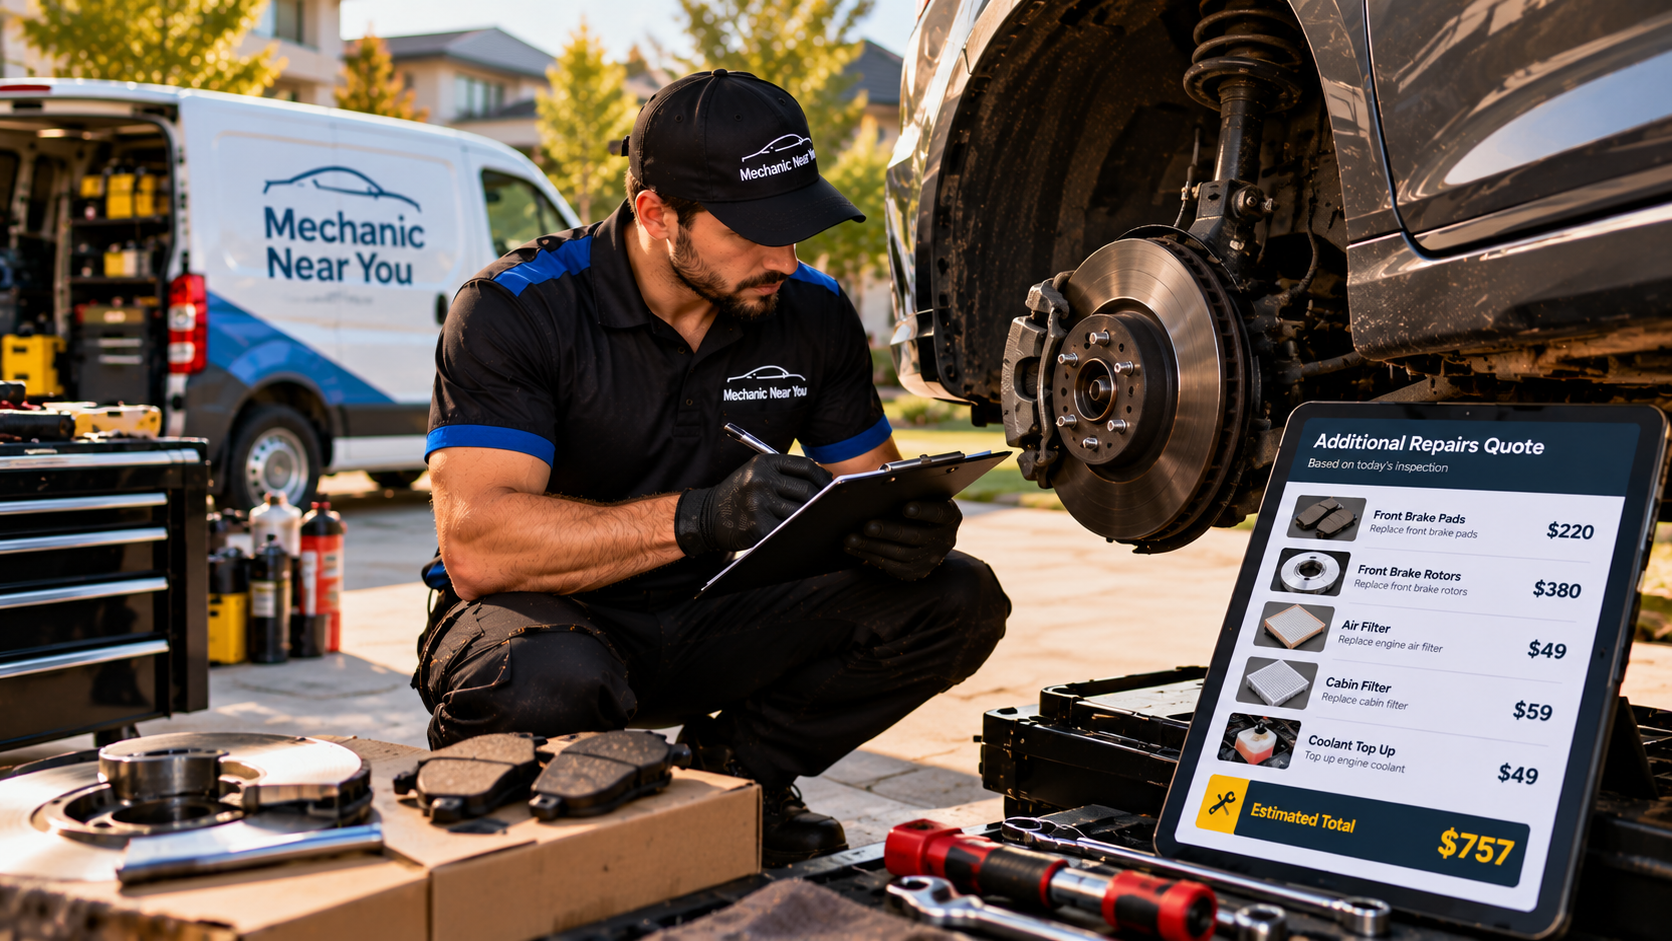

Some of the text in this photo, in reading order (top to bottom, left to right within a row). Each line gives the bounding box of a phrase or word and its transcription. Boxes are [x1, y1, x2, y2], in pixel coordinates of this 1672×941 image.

[740, 159, 792, 181] Mechanic
[792, 153, 809, 168] Near
[264, 206, 425, 249] Mechanic
[267, 246, 412, 285] Near You
[723, 385, 807, 401] Mechanic Near You
[1313, 433, 1545, 455] Additional Repairs Quote
[1308, 458, 1448, 473] Based on today's inspection
[1373, 510, 1466, 524] Front Brake Pads
[1369, 524, 1478, 540] Replace front brake pads
[1546, 520, 1595, 540] $220
[1358, 564, 1462, 582] Front Brake Rotors
[1354, 579, 1468, 596] Replace front brake rotors
[1532, 579, 1582, 599] $380
[1341, 620, 1392, 634] Air Filter
[1338, 635, 1443, 653] Replace engine air filter
[1527, 639, 1567, 660] $49
[1325, 677, 1392, 694] Cabin Filter
[1322, 692, 1408, 710] Replace cabin filter
[1513, 700, 1553, 721] $59
[1308, 735, 1396, 757] Coolant Top Up
[1304, 750, 1406, 774] Top up engine coolant
[1498, 762, 1538, 785] $49
[1250, 802, 1357, 834] Estimated Total
[1437, 827, 1516, 866] $757
